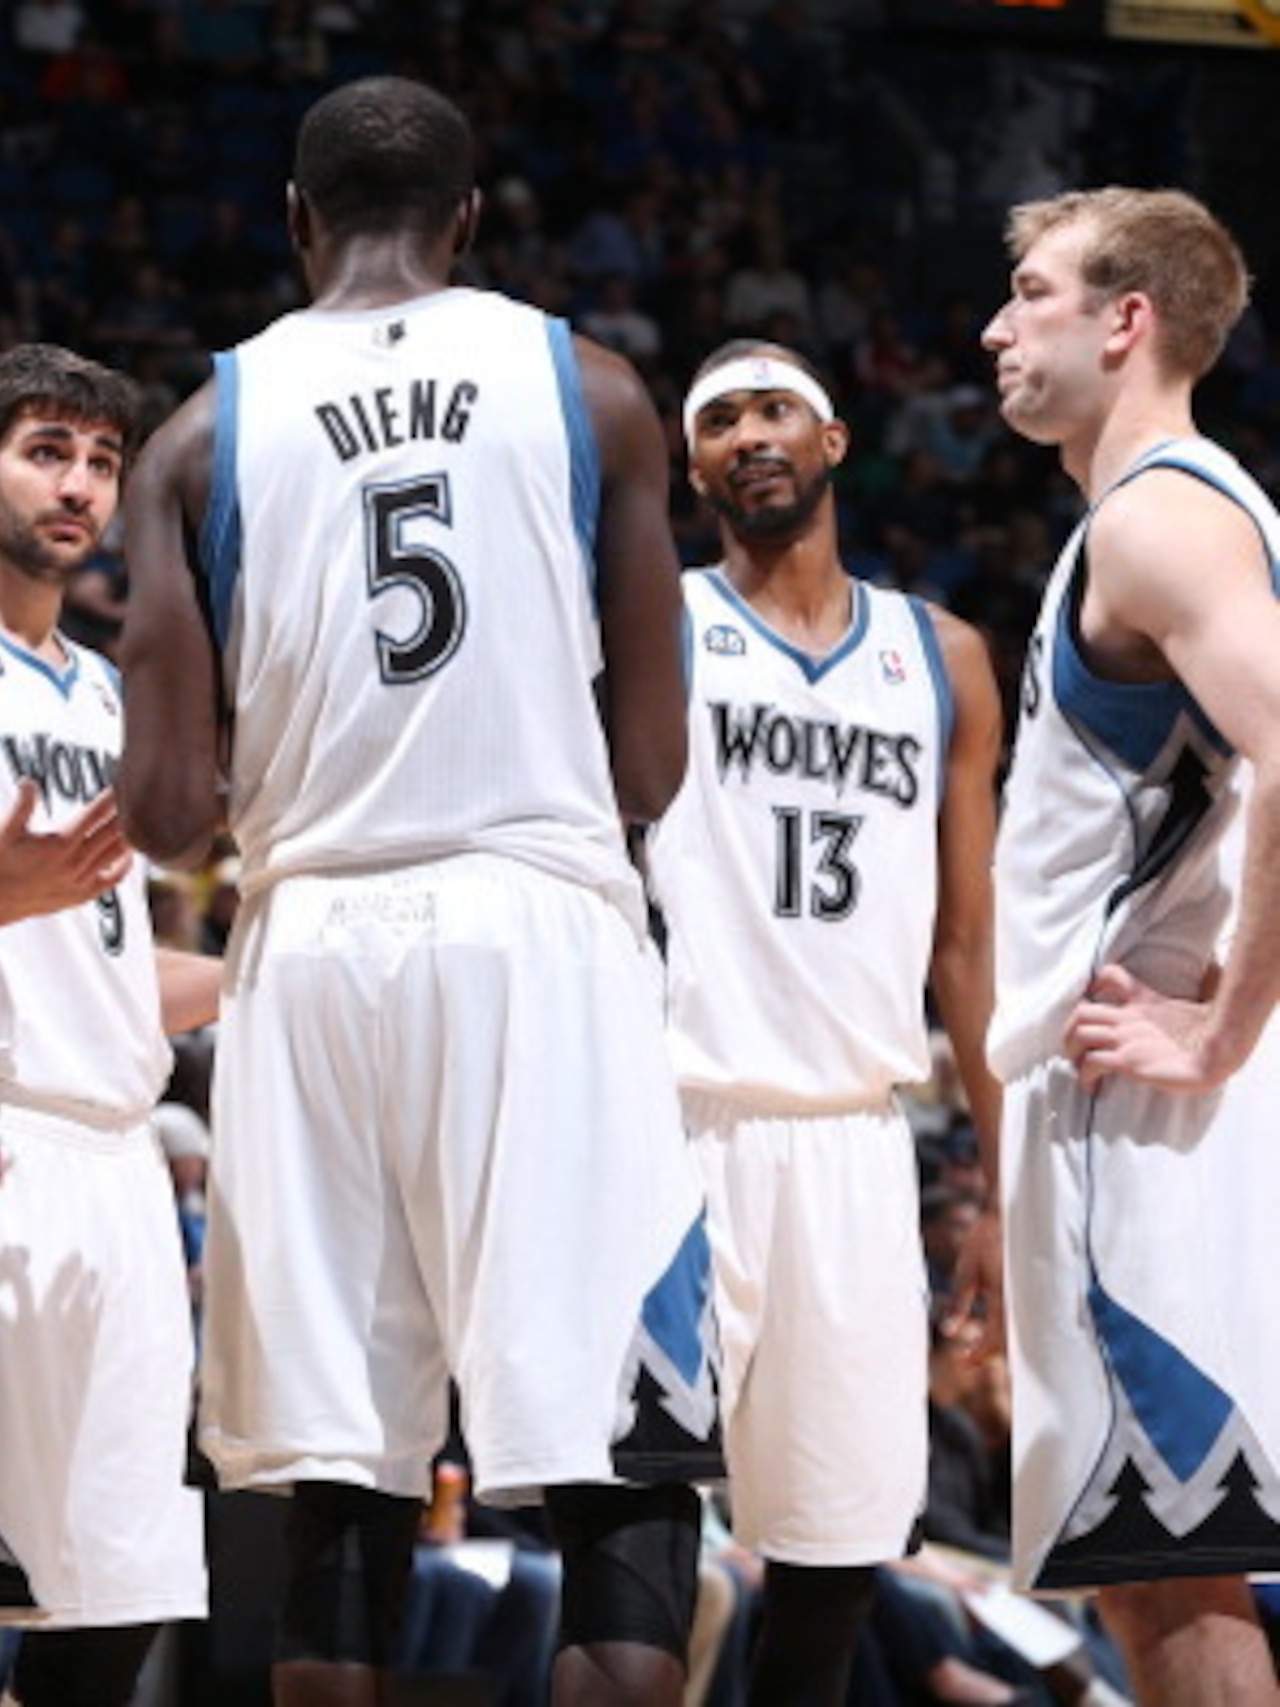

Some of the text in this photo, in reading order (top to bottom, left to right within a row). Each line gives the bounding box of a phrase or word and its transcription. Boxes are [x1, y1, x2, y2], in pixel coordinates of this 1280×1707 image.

[315, 378, 479, 462] DIENG
[362, 471, 467, 685] 5
[707, 701, 923, 810] WOLVES
[772, 806, 865, 922] 13
